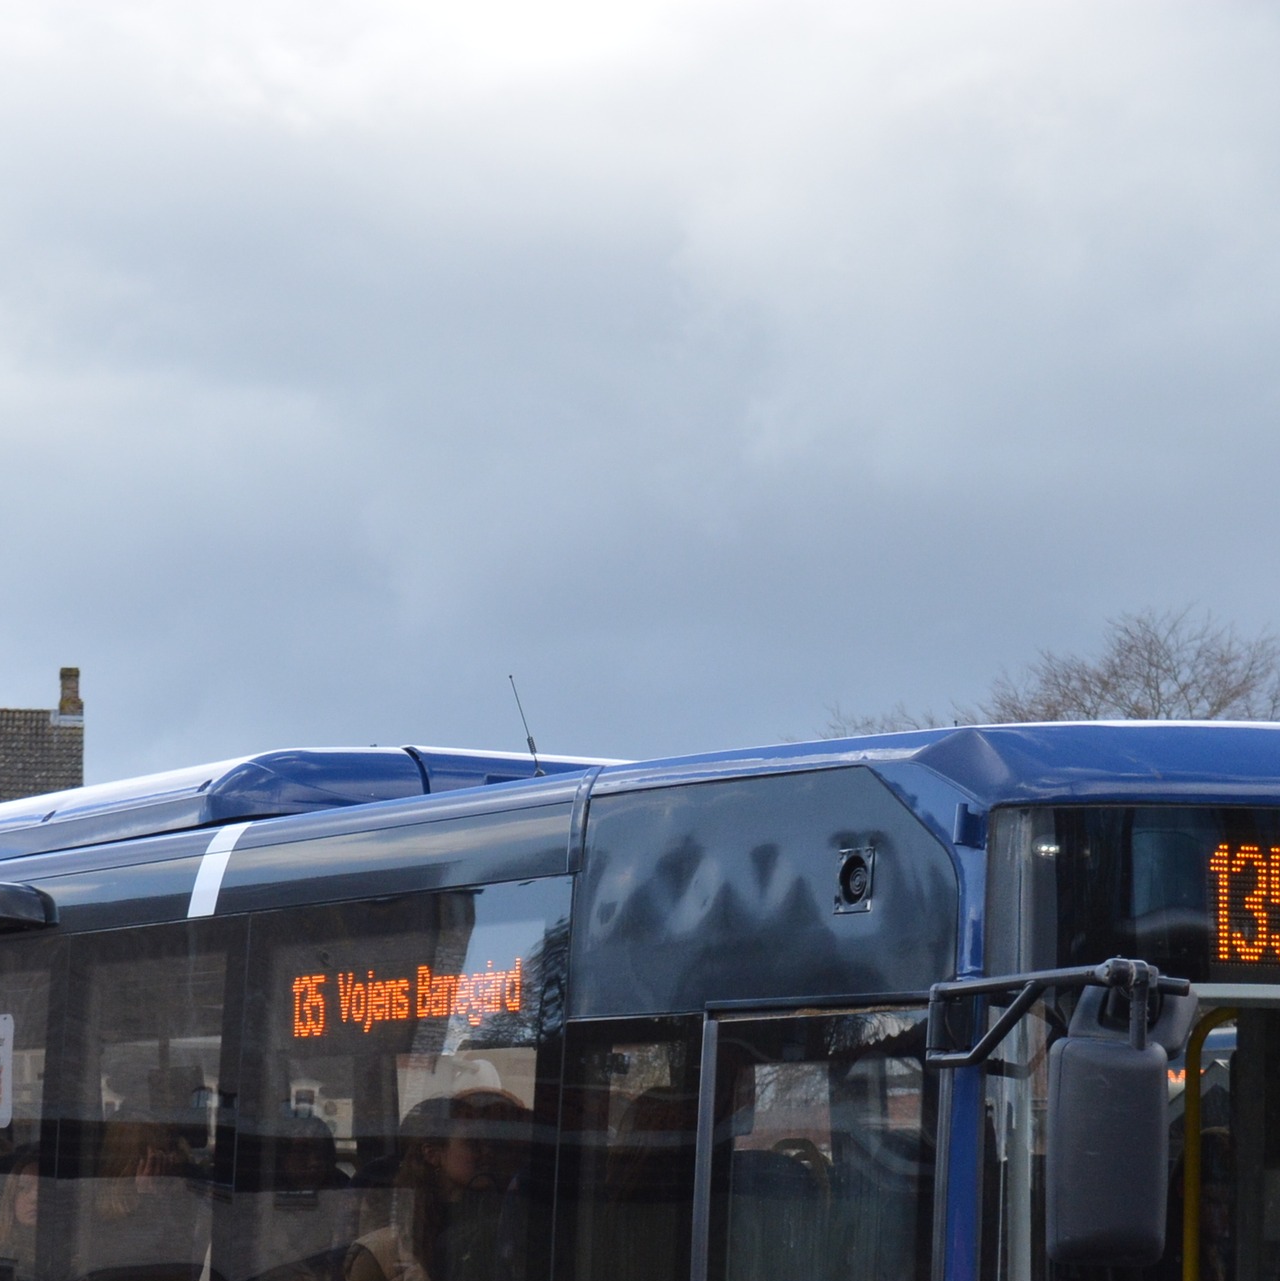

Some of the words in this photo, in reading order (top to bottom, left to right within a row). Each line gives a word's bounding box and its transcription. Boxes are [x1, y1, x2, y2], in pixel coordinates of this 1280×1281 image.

[292, 974, 325, 1037] 135
[338, 970, 410, 1033] Vojens
[416, 957, 522, 1026] Banegård
